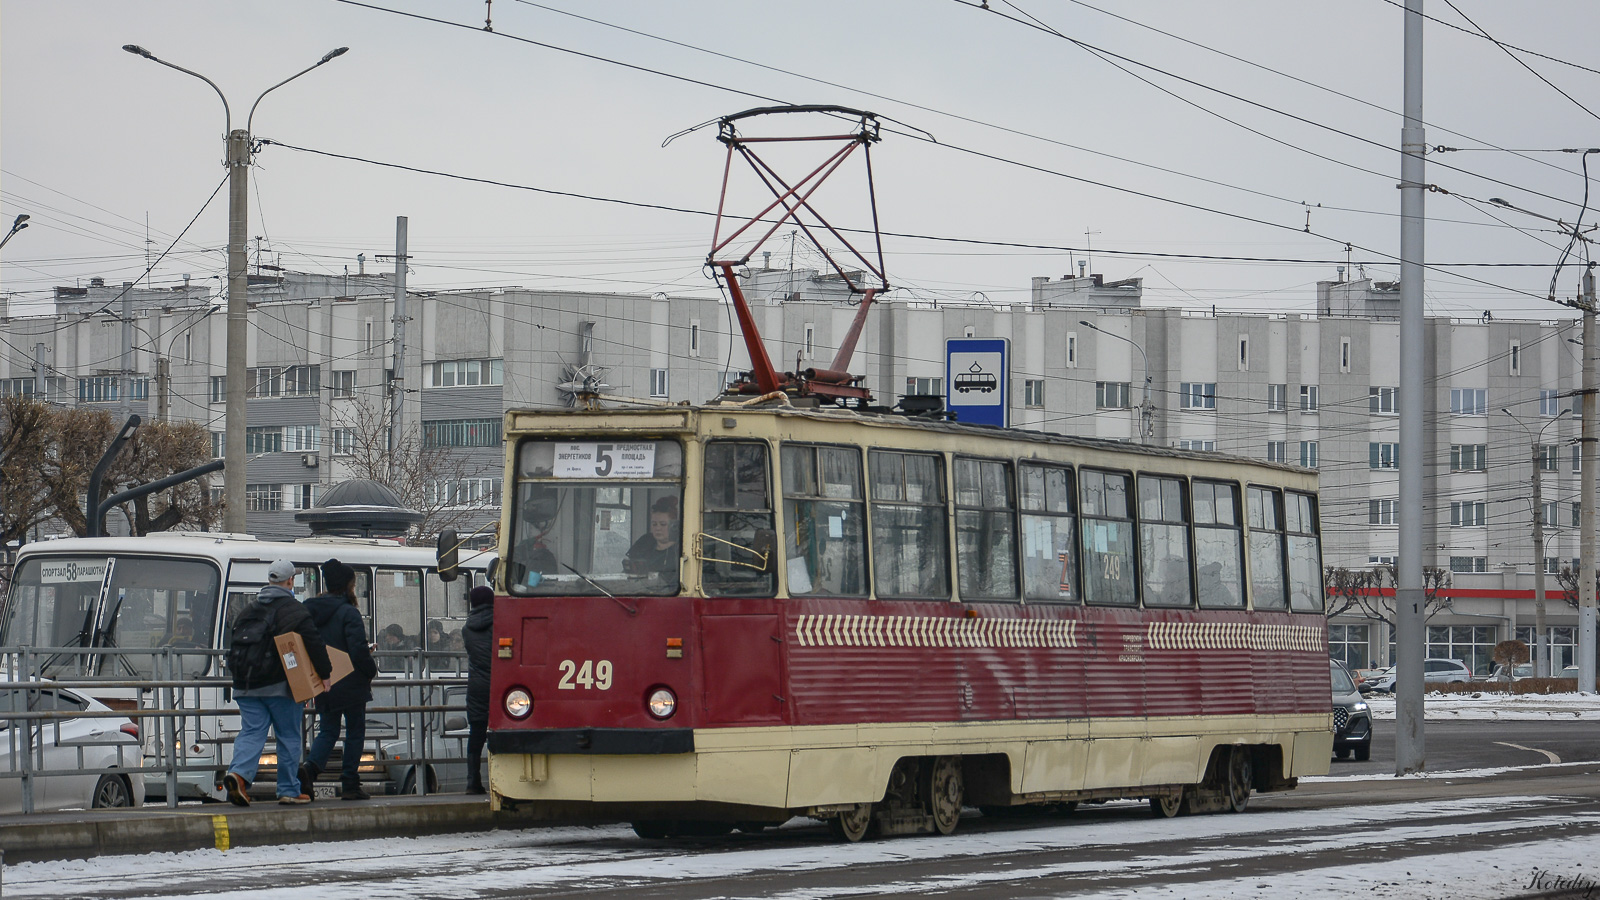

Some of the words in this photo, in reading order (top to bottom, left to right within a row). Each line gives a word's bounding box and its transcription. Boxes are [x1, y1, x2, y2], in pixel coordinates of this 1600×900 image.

[595, 444, 613, 477] 5
[621, 453, 646, 461] ПЛОЩАДЬ
[42, 567, 66, 578] СПОРТЗАЛ
[66, 563, 77, 581] 58
[77, 566, 106, 576] ПАРАШЮТНА
[1103, 554, 1120, 580] 249
[1412, 602, 1418, 614] 1
[558, 659, 613, 691] 249
